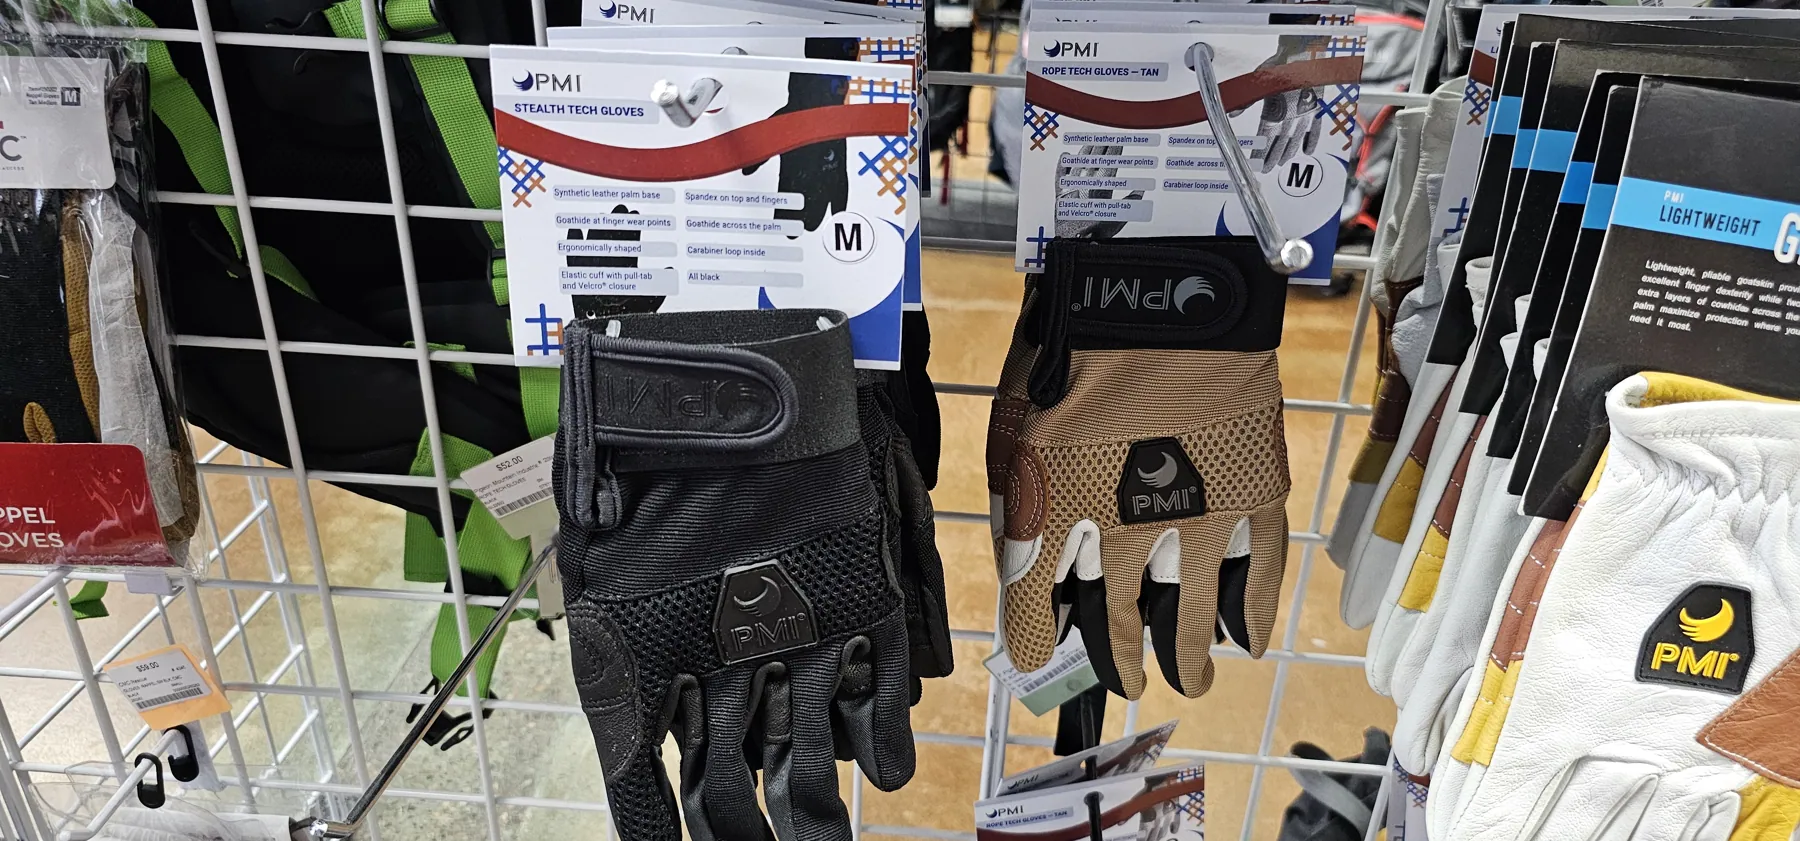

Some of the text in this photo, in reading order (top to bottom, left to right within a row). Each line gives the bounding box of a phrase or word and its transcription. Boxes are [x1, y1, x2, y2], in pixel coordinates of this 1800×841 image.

[617, 4, 654, 24] PMI
[1061, 42, 1098, 58] PMI
[1042, 67, 1066, 75] ROPE
[1068, 67, 1092, 76] TECH
[1094, 68, 1129, 76] GLOVES
[1140, 68, 1159, 77] TAN
[536, 73, 582, 92] PMI
[64, 90, 77, 103] M
[515, 103, 644, 117] STEALTH TECH GLOVES
[1064, 134, 1092, 143] Synthetic
[1116, 136, 1132, 144] palm
[1168, 136, 1195, 144] Spandex
[1098, 157, 1118, 166] finger
[1134, 158, 1154, 166] points
[1286, 162, 1314, 189] M
[1060, 179, 1103, 187] Ergonomically
[1194, 182, 1209, 190] loop
[1209, 182, 1228, 190] inside
[554, 188, 661, 199] Synthetic leather palm base
[685, 192, 717, 201] Spandex
[731, 195, 743, 203] top
[762, 197, 788, 205] fingers
[1664, 190, 1684, 203] PMI
[1108, 202, 1131, 210] pull-tab
[556, 216, 590, 225] Goathide
[593, 217, 600, 225] at
[602, 217, 624, 226] finger
[647, 218, 671, 227] points
[686, 219, 781, 231] Goathide across the palm
[1659, 205, 1762, 236] LIGHTWEIGHT
[834, 223, 862, 251] M
[1773, 212, 1800, 264] G
[558, 243, 642, 253] Ergonomically shaped
[687, 246, 766, 256] Carabiner loop inside
[561, 271, 587, 279] Elastic
[589, 271, 604, 279] cuff
[624, 272, 652, 280] pull-tab
[700, 273, 720, 281] black
[1645, 259, 1696, 277] Lightweight,
[1701, 270, 1731, 282] pliable
[1736, 276, 1774, 289] goatskin
[562, 282, 576, 290] and
[1641, 274, 1680, 287] excellent
[1684, 280, 1710, 293] finger
[1715, 286, 1754, 301] dexterity
[1759, 294, 1782, 304] while
[1637, 288, 1660, 298] extra
[1664, 291, 1691, 303] layers
[1696, 297, 1707, 306] of
[1752, 307, 1782, 318] across
[1785, 312, 1800, 321] the
[1629, 314, 1691, 331] need it most.
[1633, 301, 1655, 311] palm
[1659, 305, 1700, 319] maximize
[1705, 313, 1749, 327] protection
[1754, 321, 1781, 332] where
[496, 455, 523, 472] $52.00
[136, 661, 160, 673] $59.00
[1016, 774, 1039, 787] PMI
[997, 805, 1024, 817] PMI
[986, 820, 1003, 828] ROPE
[1004, 818, 1021, 826] TECH
[1022, 814, 1047, 824] GLOVES
